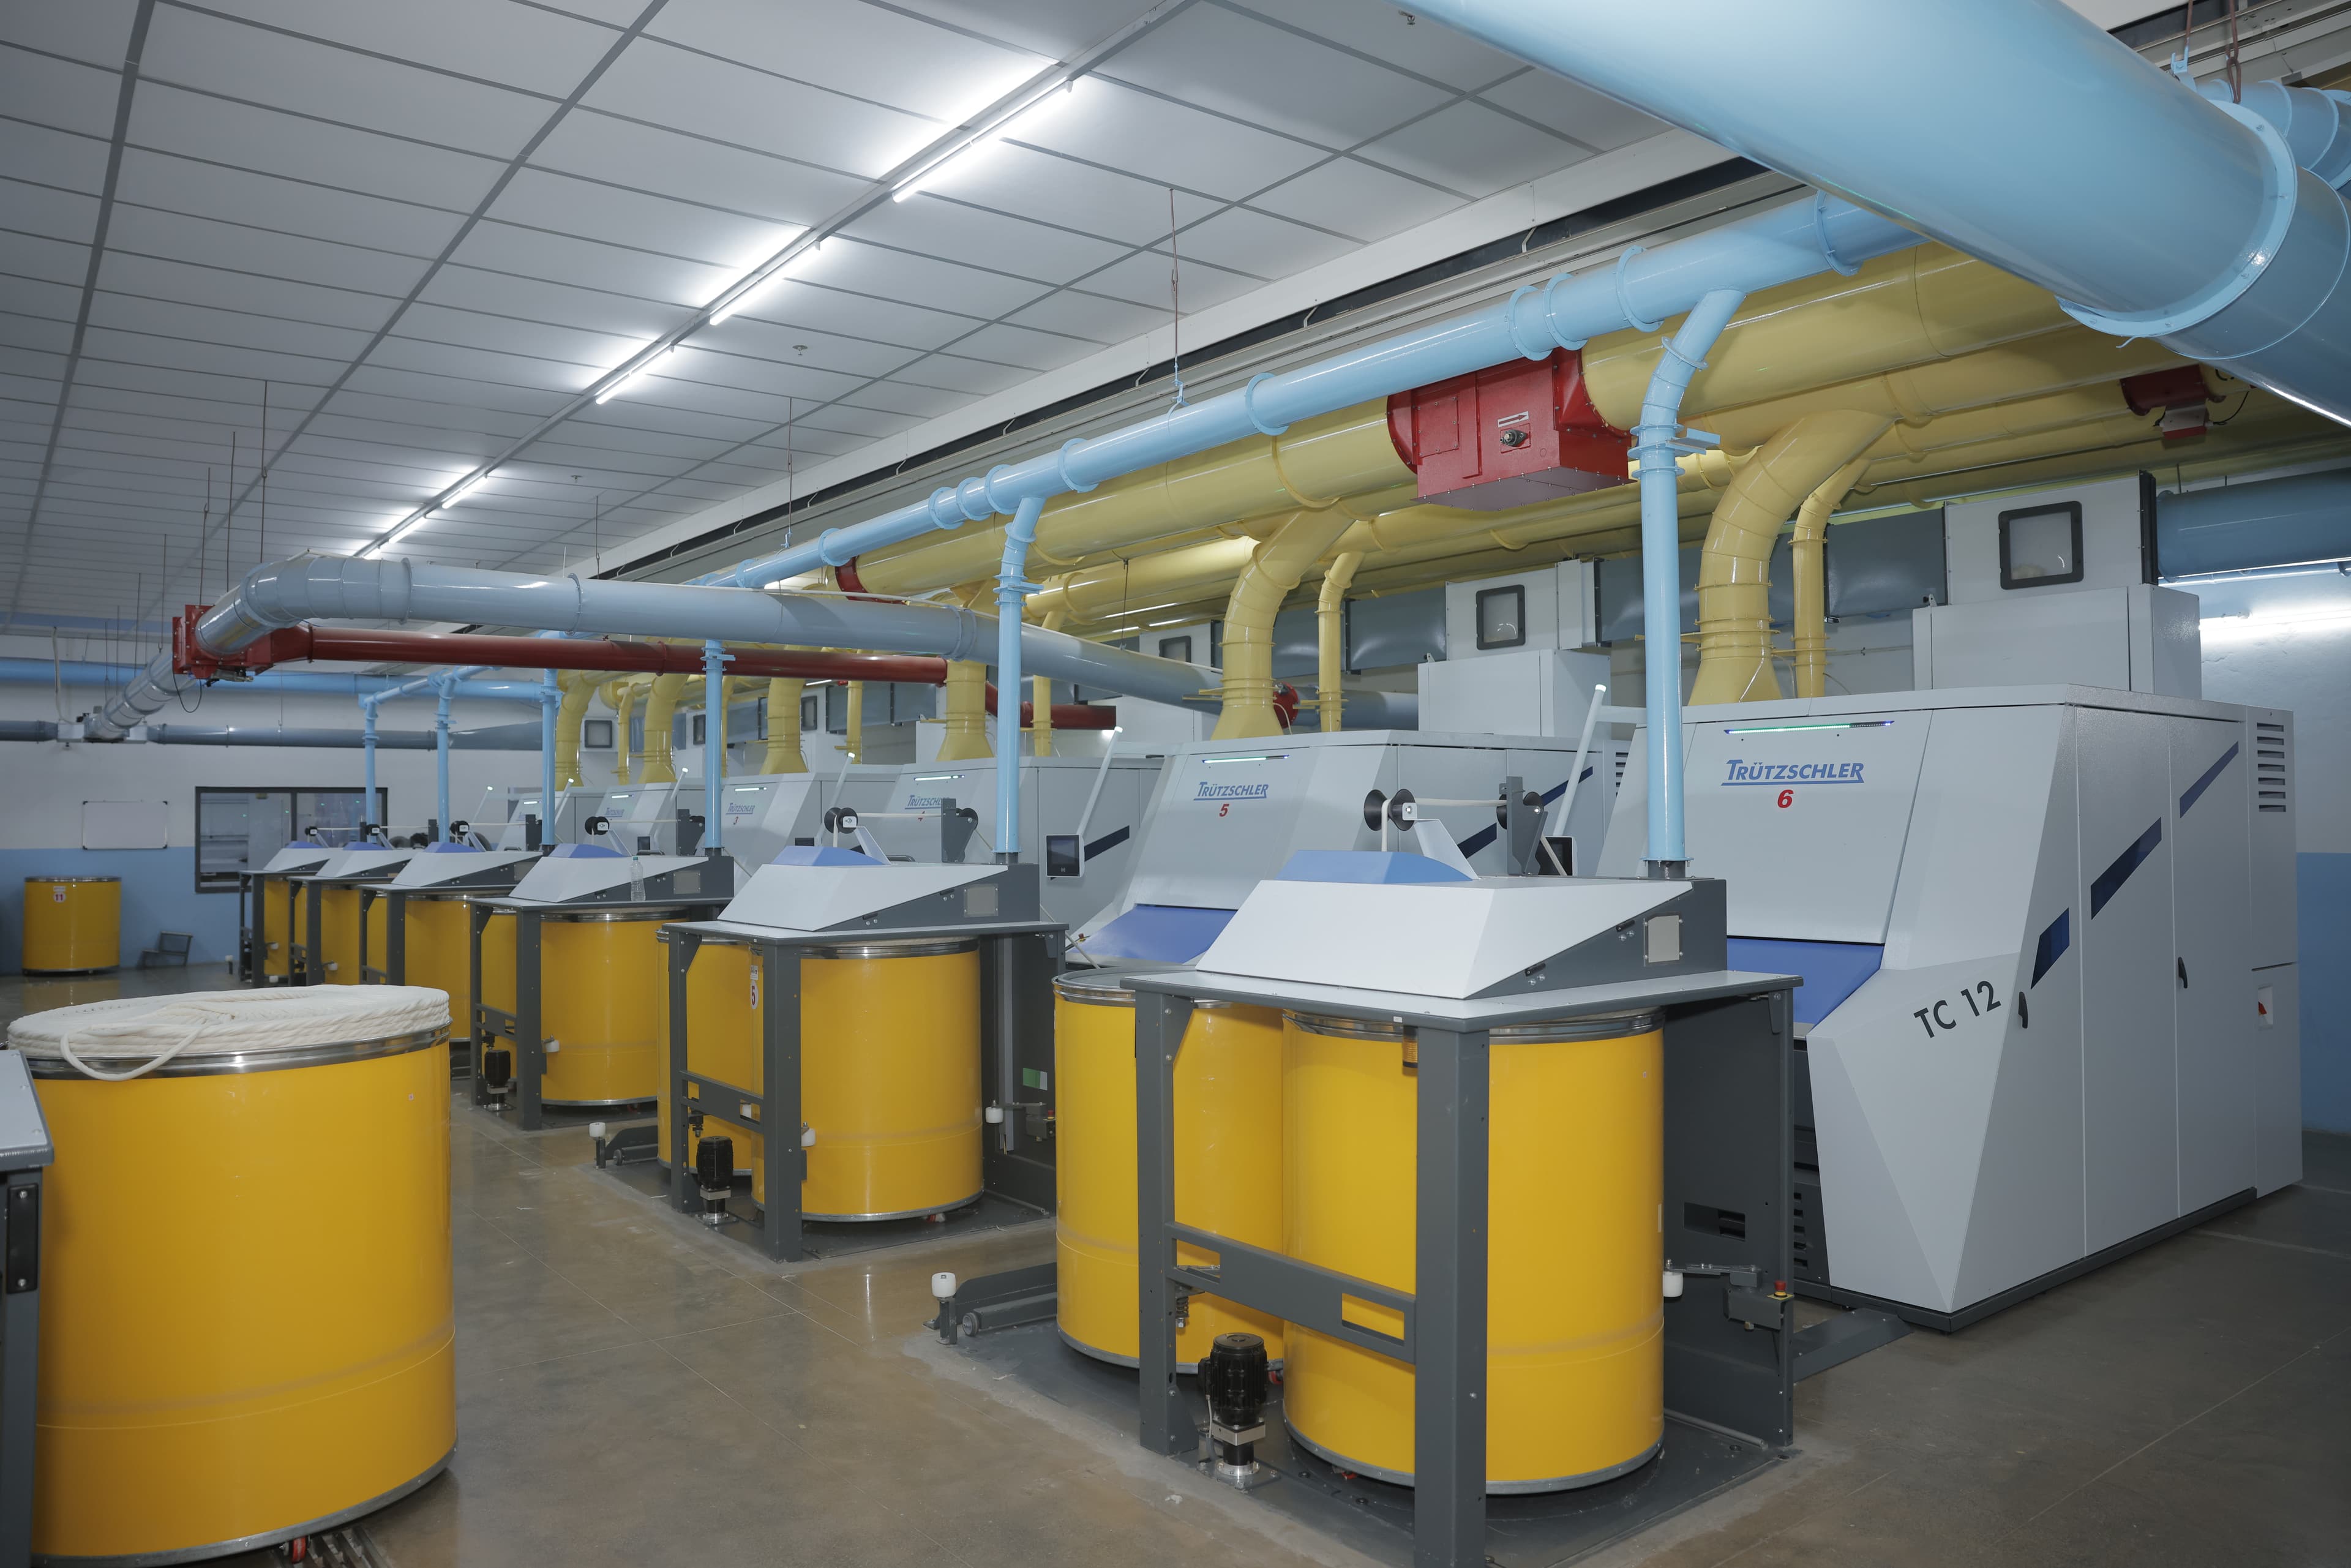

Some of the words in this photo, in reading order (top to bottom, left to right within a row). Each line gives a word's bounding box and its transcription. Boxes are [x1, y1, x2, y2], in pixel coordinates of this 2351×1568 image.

[1721, 759, 1864, 786] TRÜTZSCHLER
[1195, 781, 1269, 800] TRÜTZSCHLER
[1777, 789, 1794, 809] 6
[906, 794, 948, 809] TRÜTZSCHL
[1219, 803, 1229, 817] 5
[751, 985, 756, 1005] 5
[1913, 1000, 1957, 1038] TC
[1960, 980, 2001, 1017] 12
